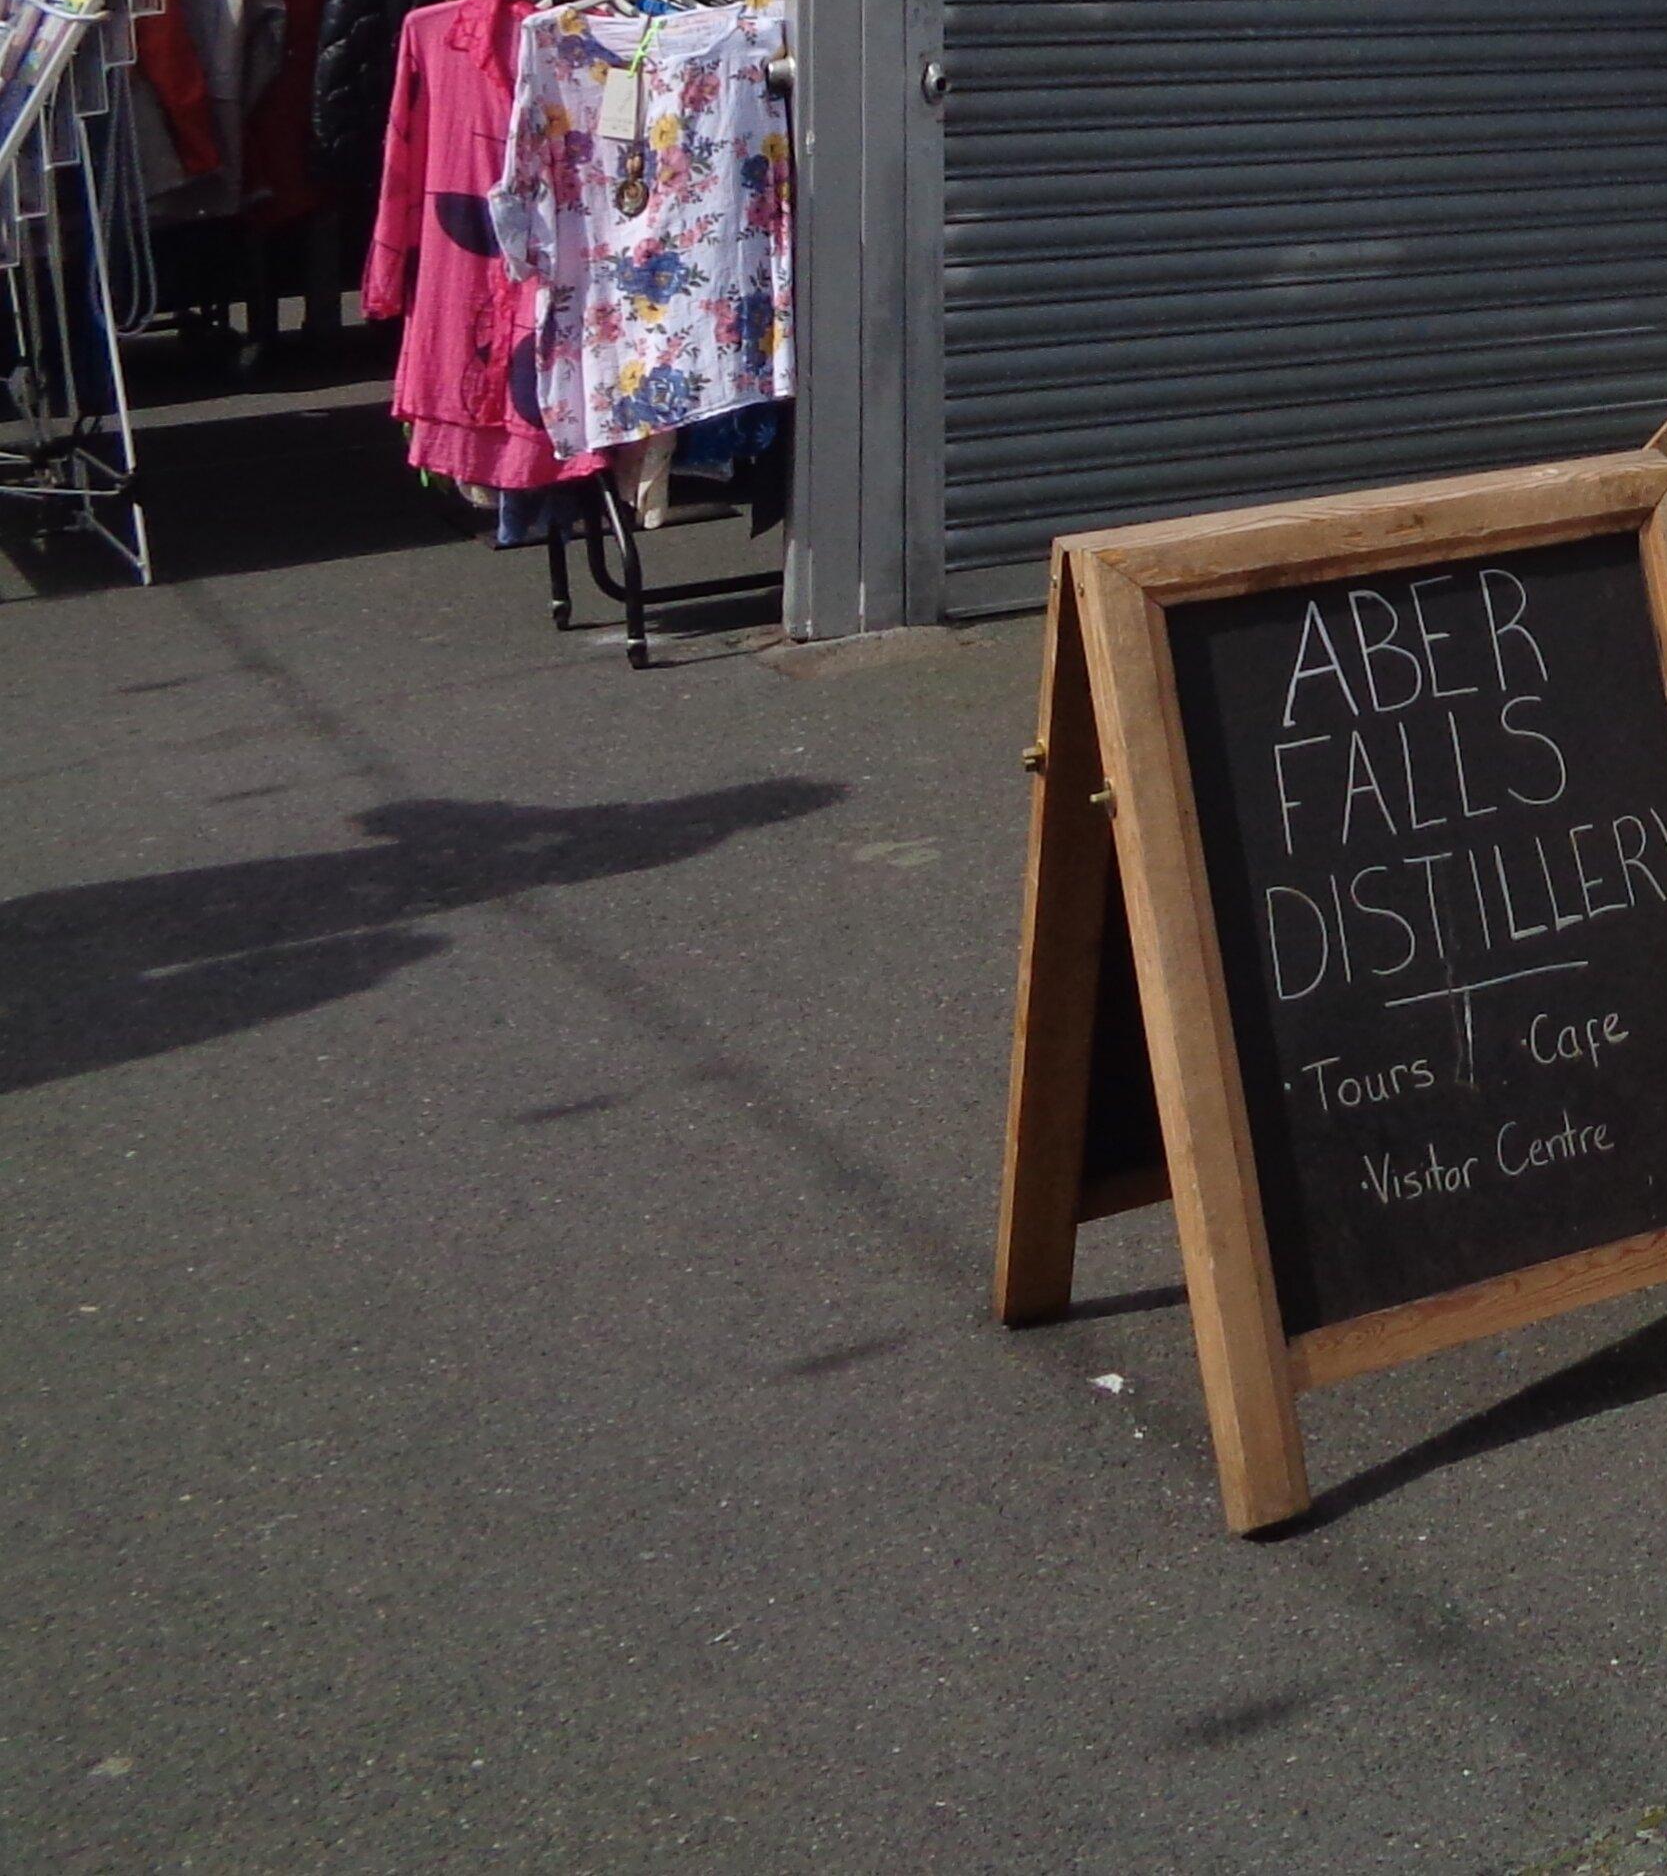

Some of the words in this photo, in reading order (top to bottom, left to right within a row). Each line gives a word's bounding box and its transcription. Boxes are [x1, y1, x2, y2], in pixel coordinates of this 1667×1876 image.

[1282, 568, 1550, 729] ABER
[1273, 694, 1568, 856] FALLS
[1301, 1055, 1436, 1113] Tours
[1529, 1011, 1631, 1069] Cafe
[1363, 1142, 1479, 1205] Visitor
[1496, 1108, 1616, 1177] Centre
